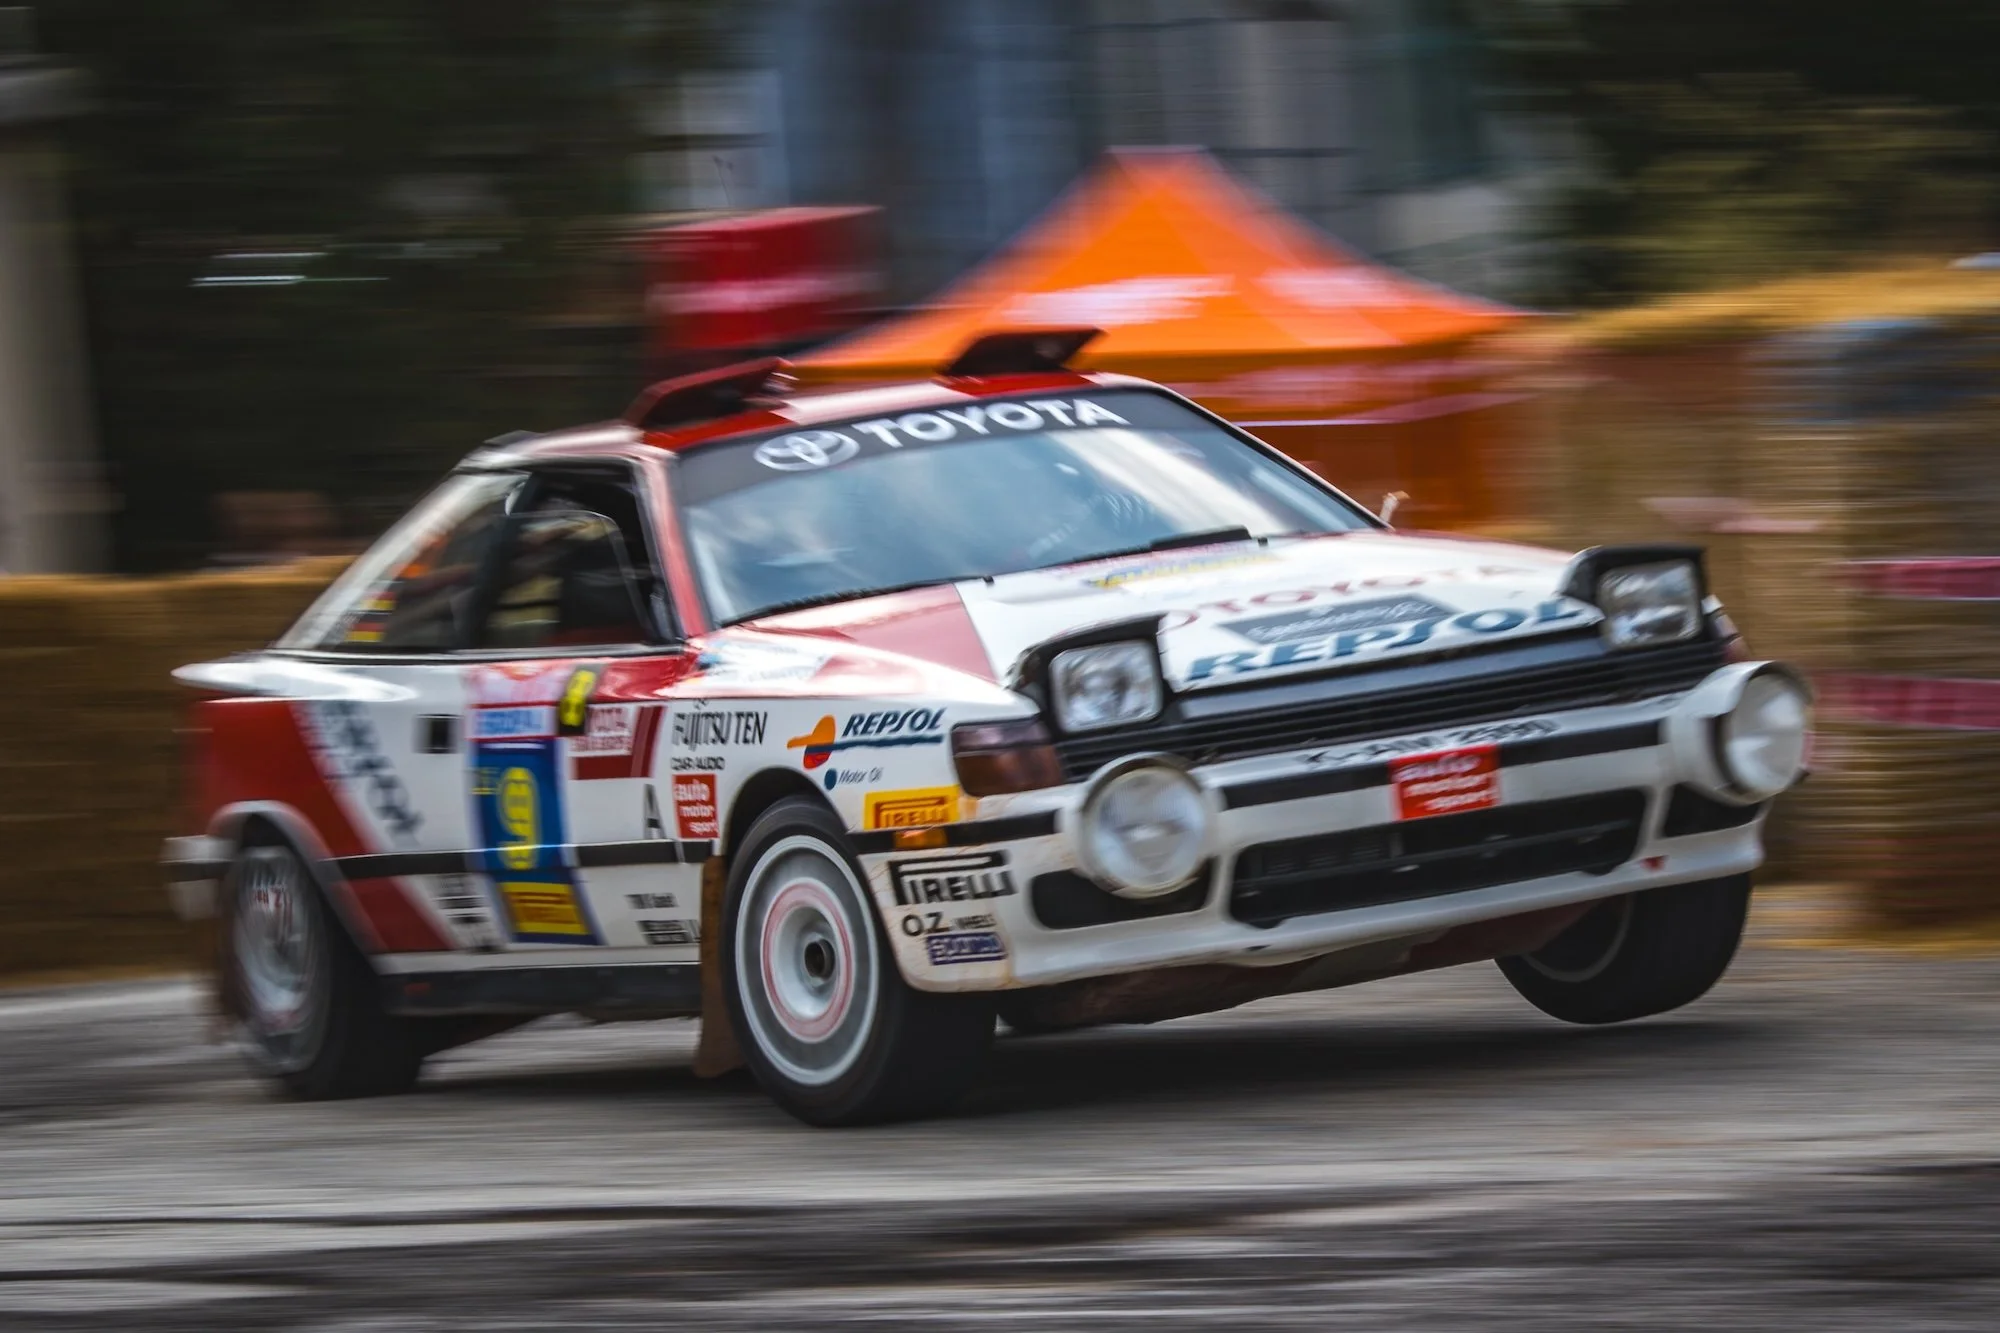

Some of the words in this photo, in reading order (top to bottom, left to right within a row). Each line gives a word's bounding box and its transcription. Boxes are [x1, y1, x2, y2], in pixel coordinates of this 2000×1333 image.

[852, 397, 1132, 449] TOYOTA
[1184, 599, 1583, 683] REPSOL
[733, 711, 768, 745] TEN
[841, 707, 948, 737] REPSOL
[673, 778, 710, 802] auto
[498, 766, 540, 870] 9
[680, 803, 716, 818] motor
[873, 795, 951, 829] PIRELLI
[888, 848, 1019, 906] PIRELLI
